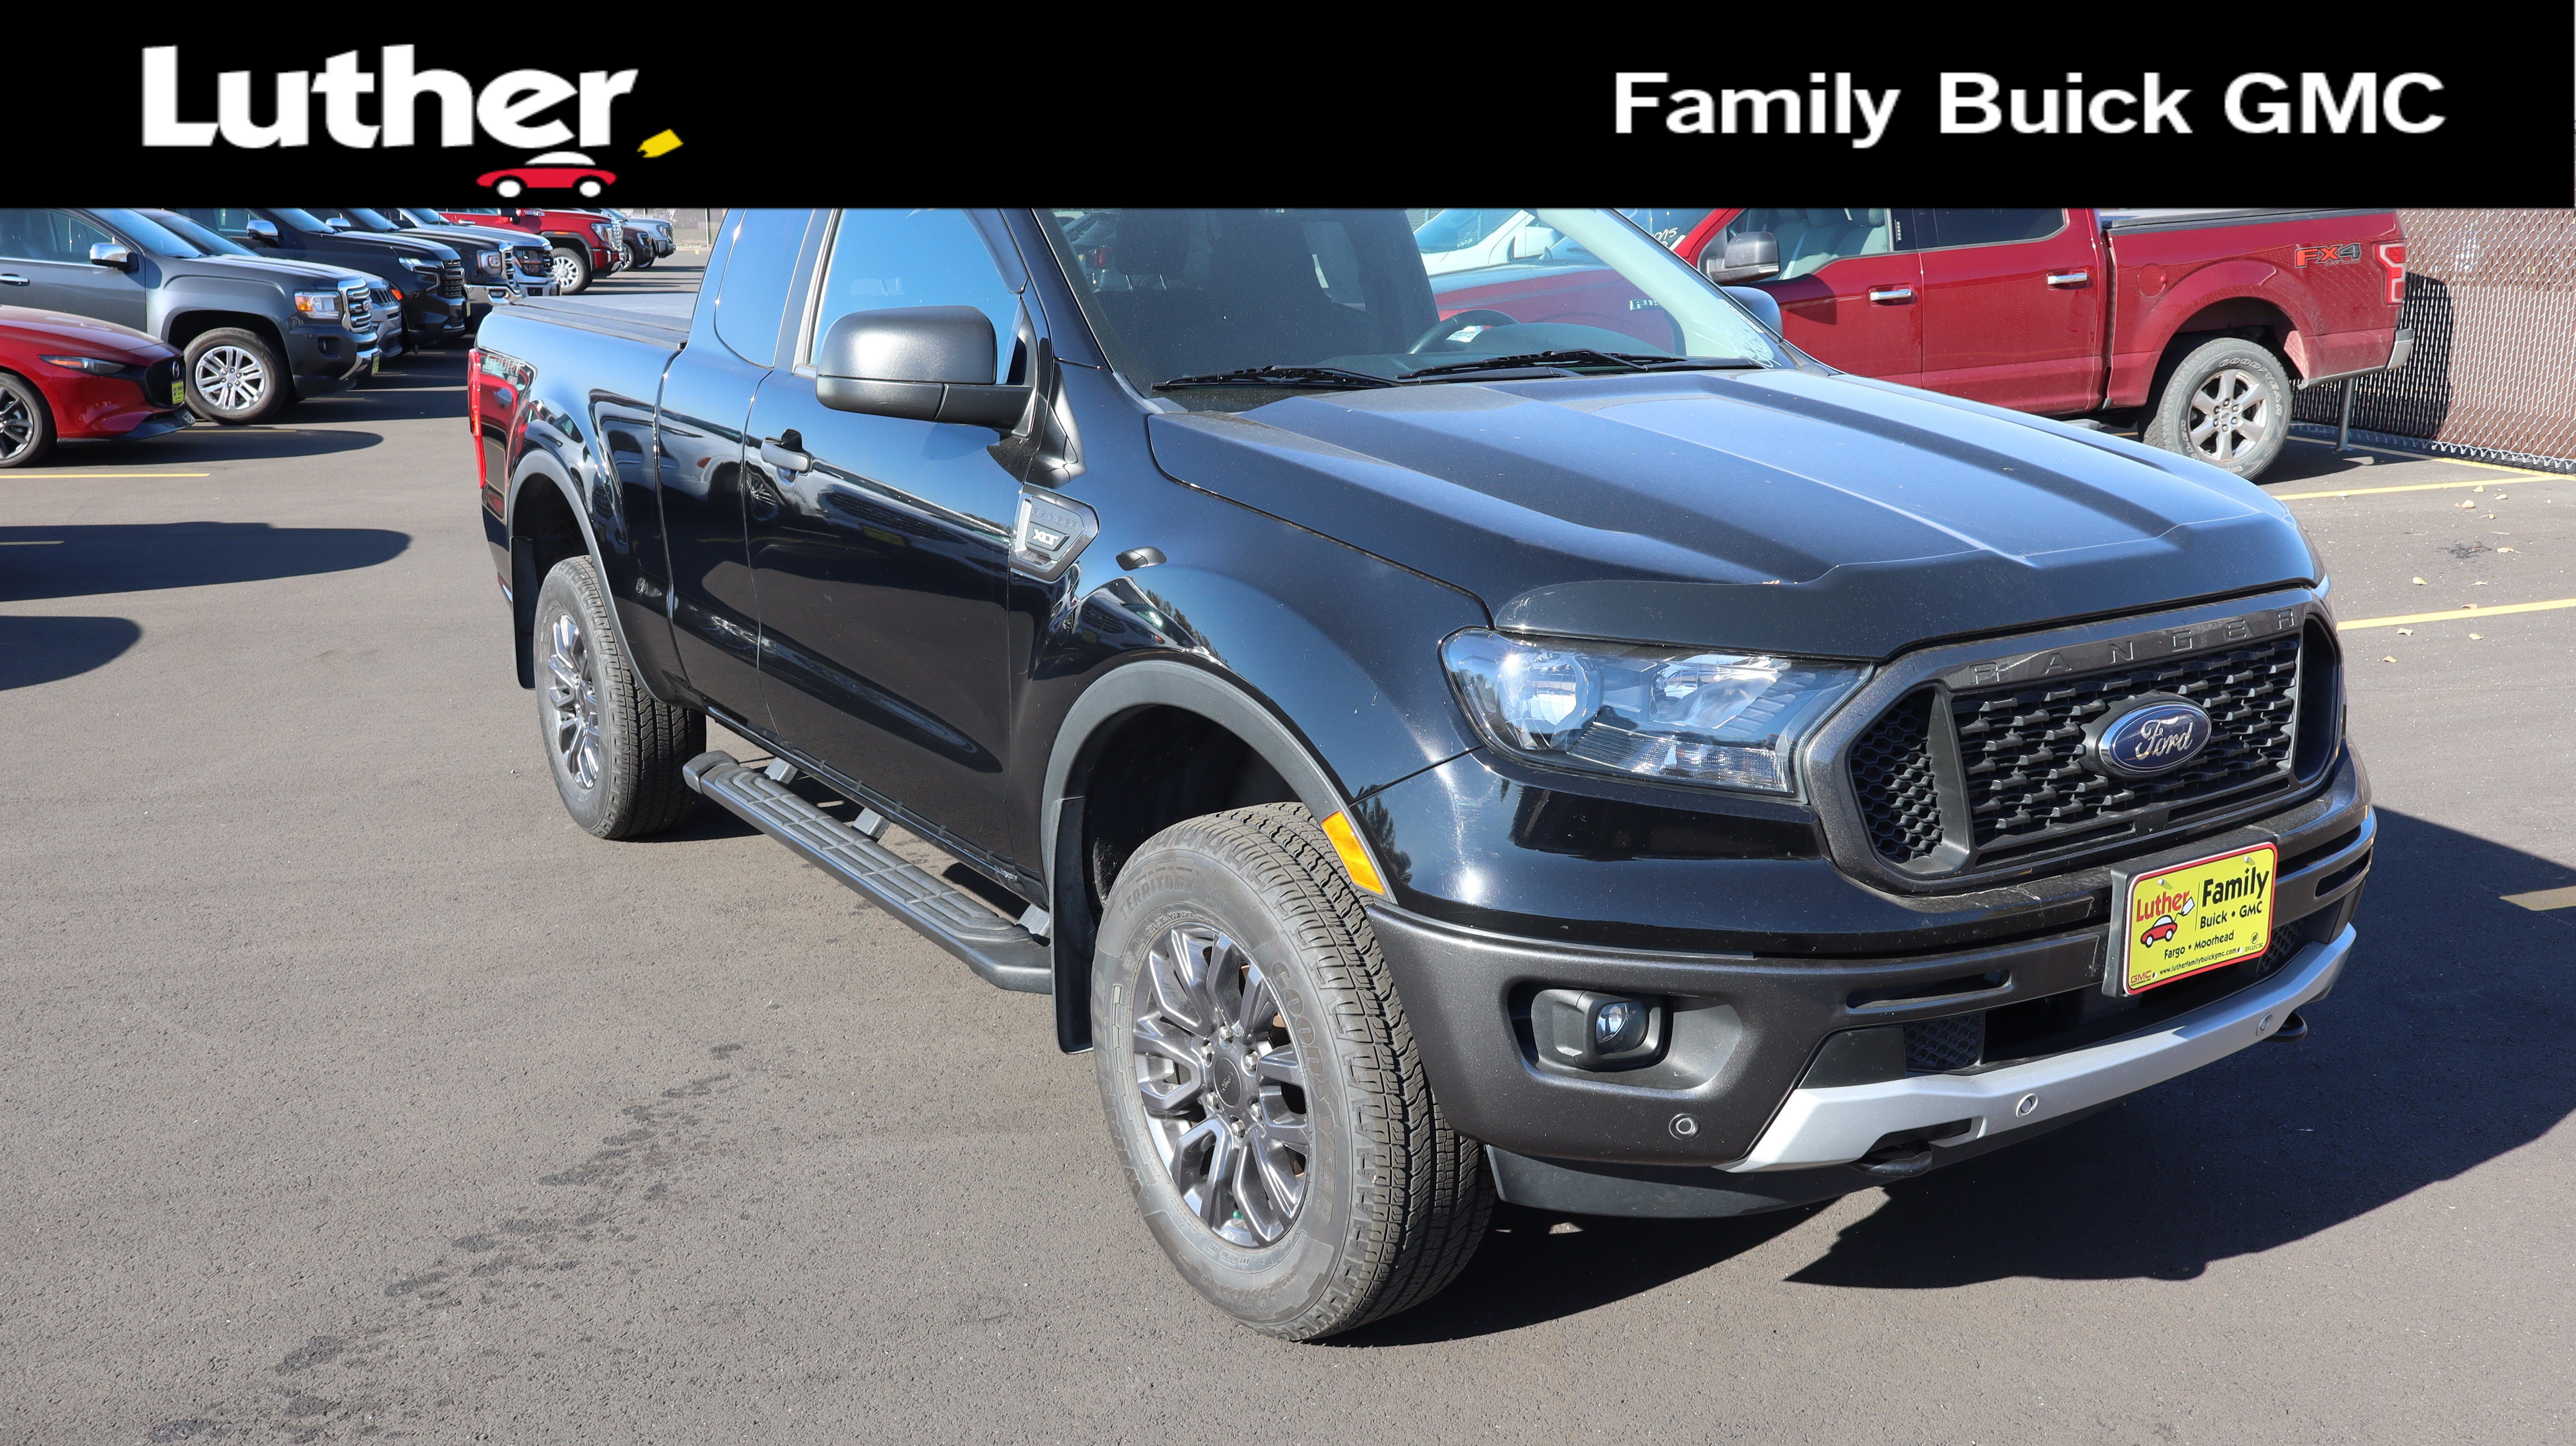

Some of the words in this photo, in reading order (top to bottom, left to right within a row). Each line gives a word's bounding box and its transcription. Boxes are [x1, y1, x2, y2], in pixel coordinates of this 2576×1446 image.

[2295, 242, 2361, 268] FX4
[482, 354, 525, 376] SPORT
[2219, 358, 2283, 416] GOODYEAR
[1031, 507, 1079, 531] RANGER
[1032, 528, 1059, 546] XLT
[1969, 608, 2294, 685] RANGER
[2135, 716, 2193, 760] Ford
[1119, 874, 1196, 921] TERRITORY
[2136, 890, 2190, 923] Luther
[2202, 866, 2270, 907] Family
[2200, 910, 2228, 929] Buick
[2239, 900, 2263, 918] GMC
[2164, 946, 2186, 960] Fargo
[2193, 931, 2234, 951] Moorhead
[2245, 942, 2263, 952] BUICK
[2159, 948, 2237, 975] www.lutherfamilybuickgmc.com
[2131, 970, 2152, 984] GMC
[1091, 969, 1143, 1200] WRANGLER
[1272, 961, 1337, 1226] GOODYEAR
